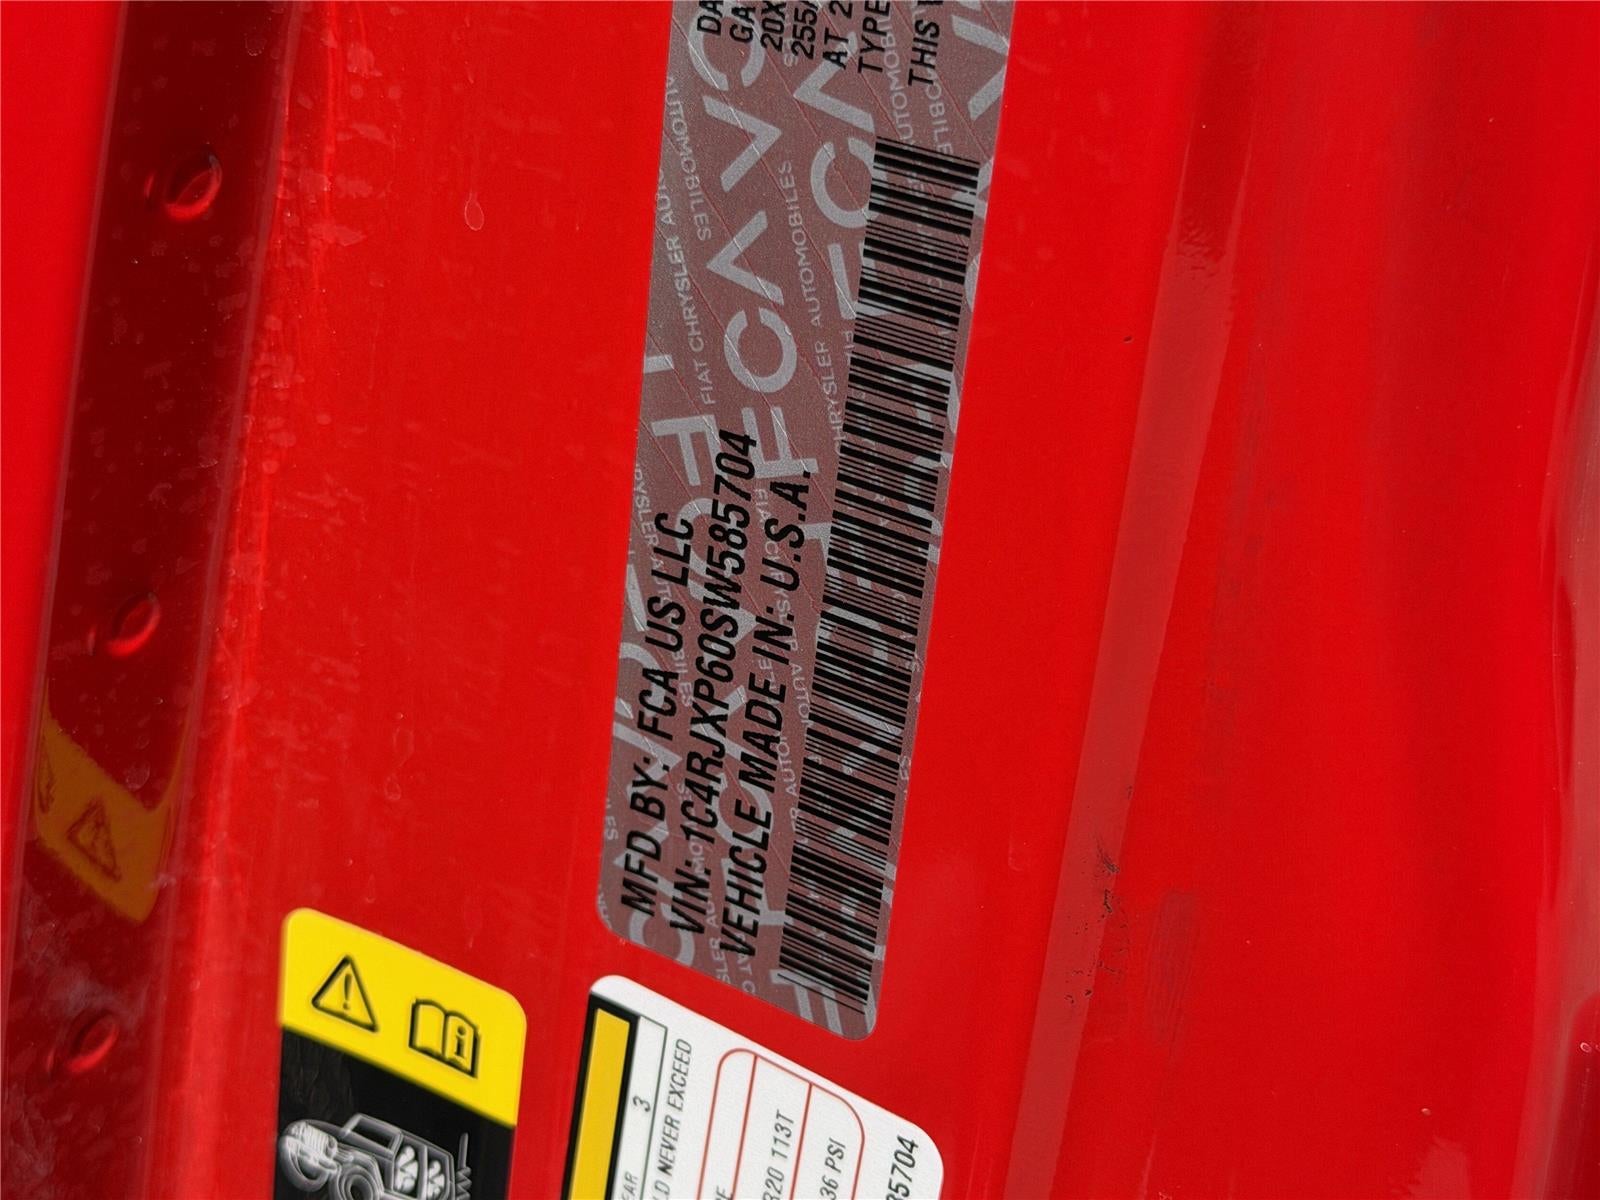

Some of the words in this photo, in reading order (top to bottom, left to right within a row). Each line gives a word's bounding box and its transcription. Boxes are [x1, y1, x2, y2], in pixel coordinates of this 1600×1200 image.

[822, 27, 849, 70] AT
[858, 0, 890, 73] TYPE
[908, 19, 940, 86] THIS
[777, 160, 823, 328] AUTOMOBILES
[651, 512, 694, 587] LLC
[759, 470, 811, 592] U.S.A.
[645, 595, 686, 651] US
[680, 429, 758, 845] 1C4RJXP60SW585704
[751, 606, 794, 665] IN:
[637, 667, 679, 740] FCA
[738, 672, 787, 792] MADE
[630, 756, 670, 823] BY:
[621, 831, 661, 917] MFD
[669, 860, 711, 934] VIN:
[719, 798, 773, 957] VEHICLE
[631, 1095, 651, 1113] 3
[667, 1038, 693, 1109] EXCEED
[657, 1114, 681, 1176] NEVER
[771, 1108, 795, 1160] 113T
[825, 1137, 847, 1174] PSI
[819, 1174, 839, 1200] 36
